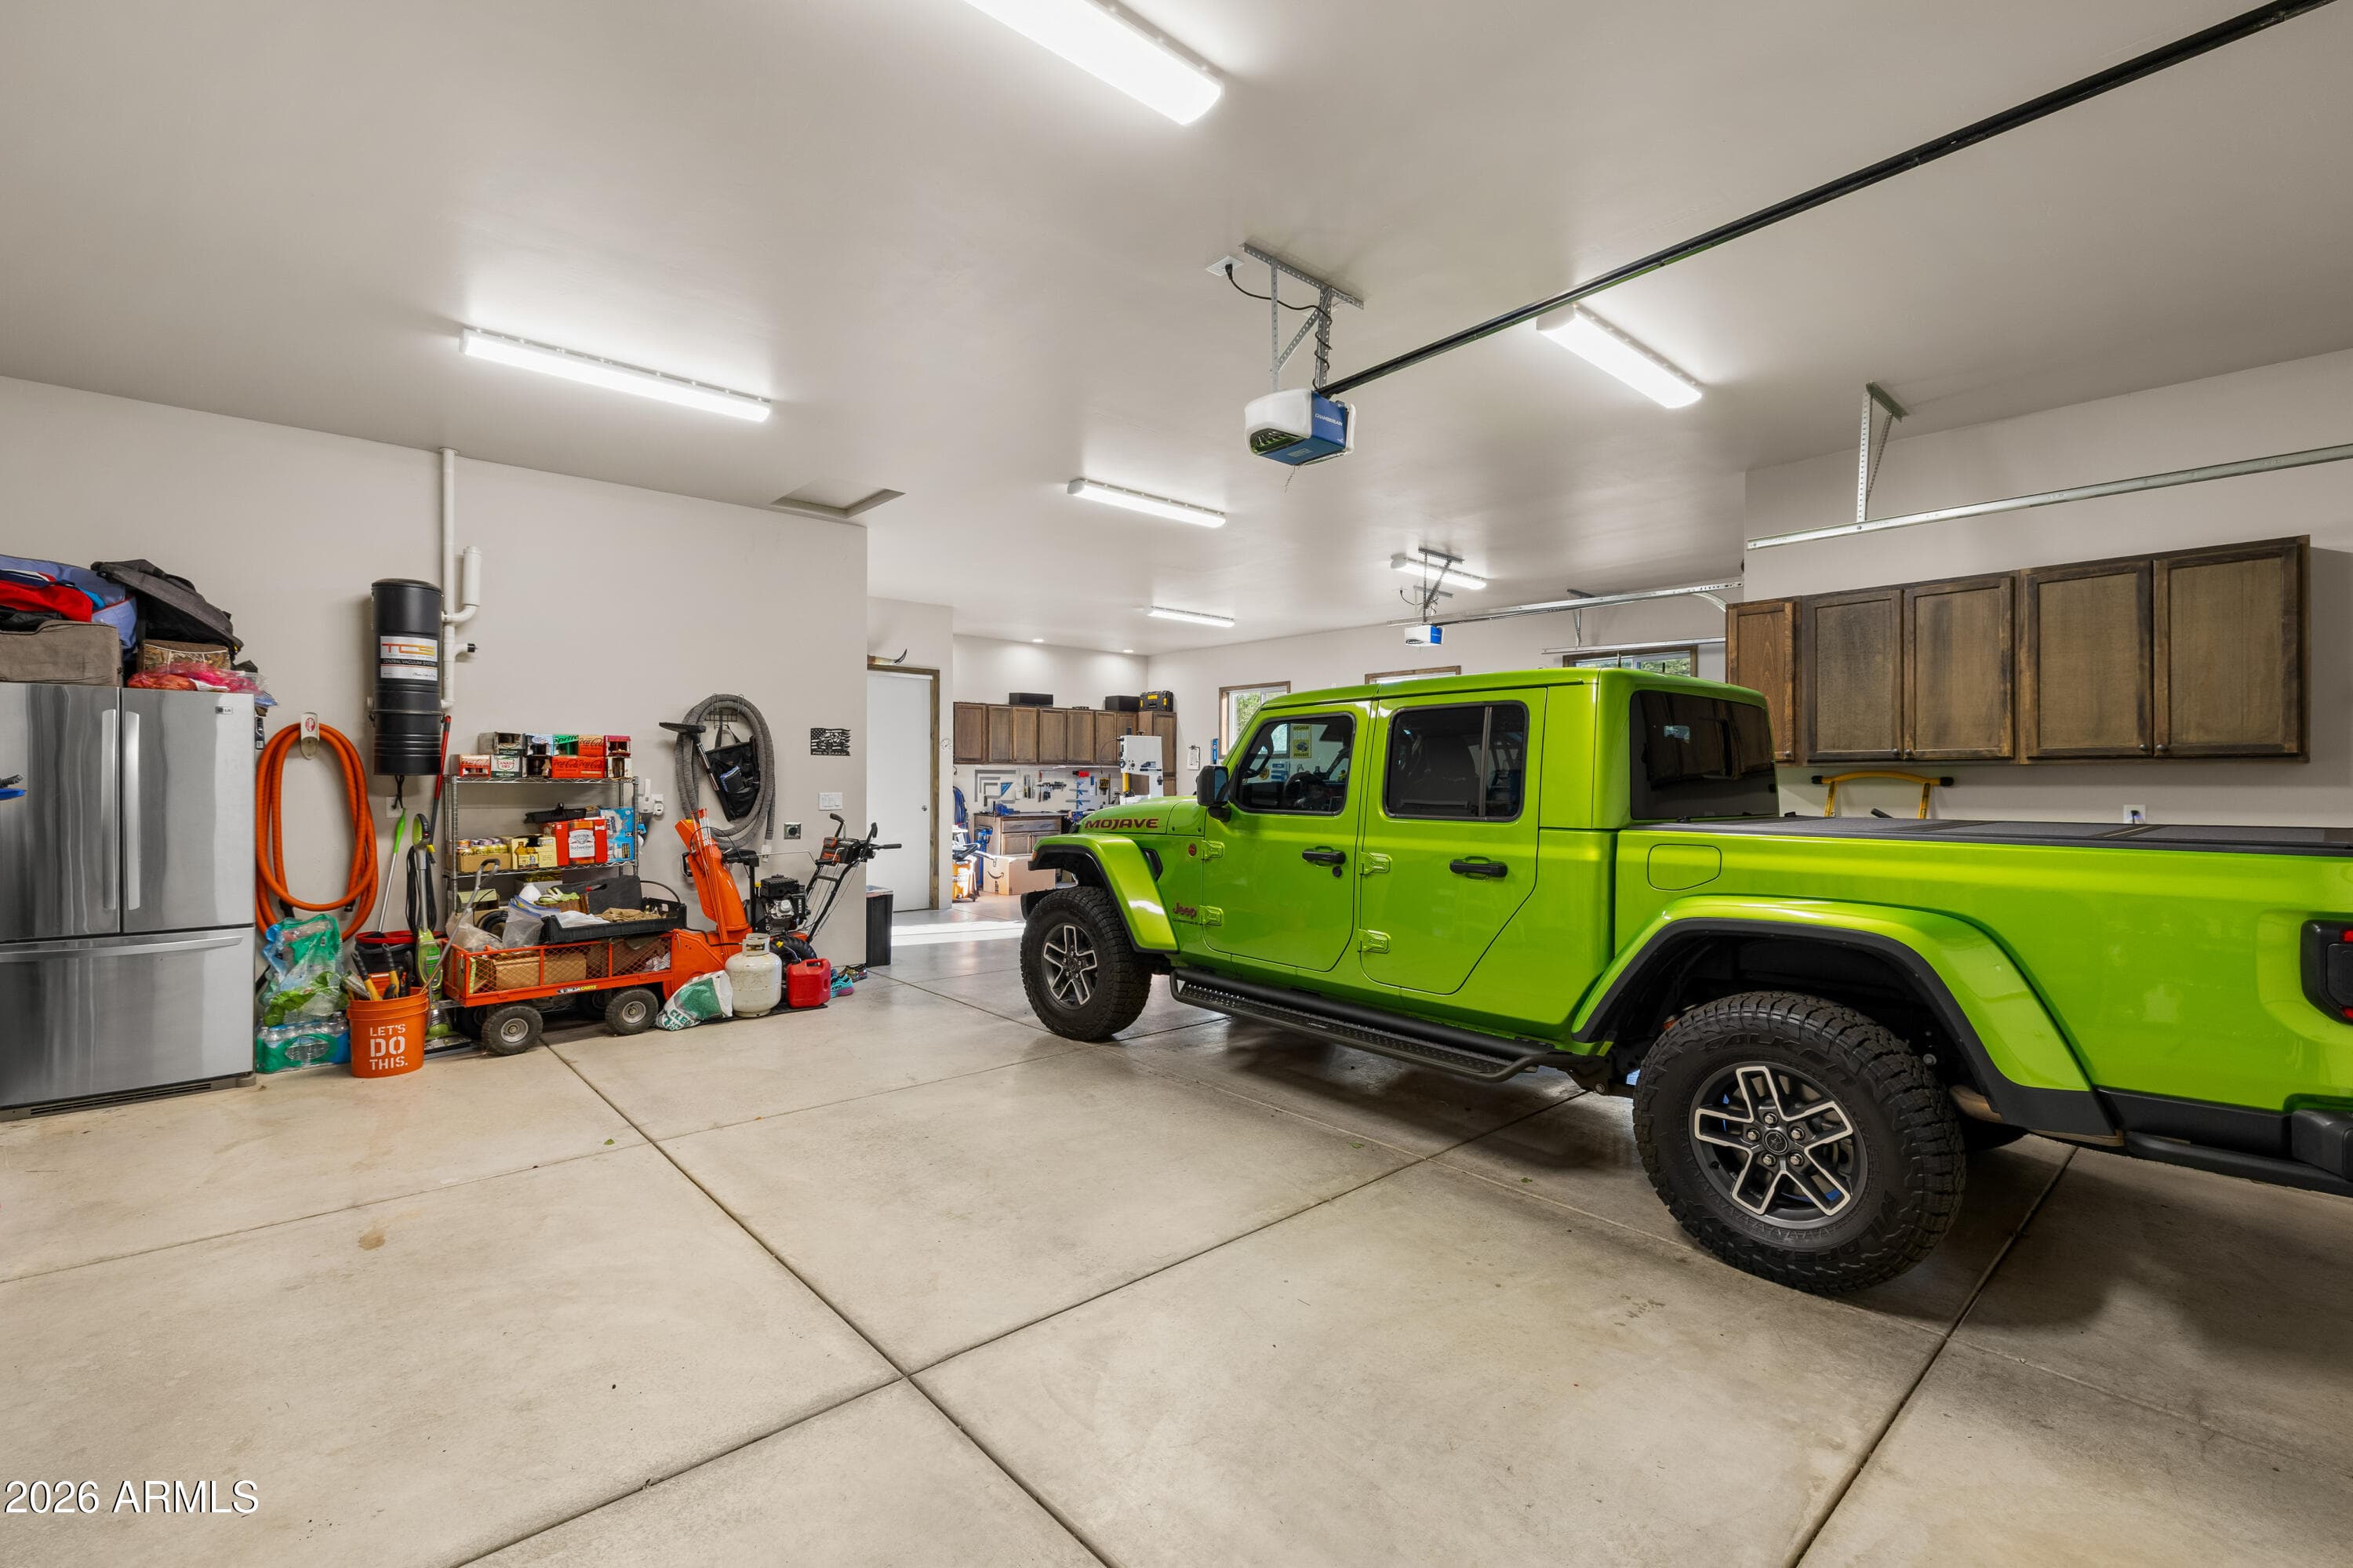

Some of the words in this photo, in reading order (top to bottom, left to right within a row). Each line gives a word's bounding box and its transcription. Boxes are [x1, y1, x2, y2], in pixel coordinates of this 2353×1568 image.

[1315, 413, 1343, 427] CHAMBERLAIN
[381, 643, 435, 656] TCS
[1084, 818, 1159, 831] MOJAVE
[1173, 902, 1197, 919] Jeep
[369, 1023, 406, 1037] LET'S
[369, 1035, 406, 1057] DO
[369, 1056, 409, 1071] THIS.
